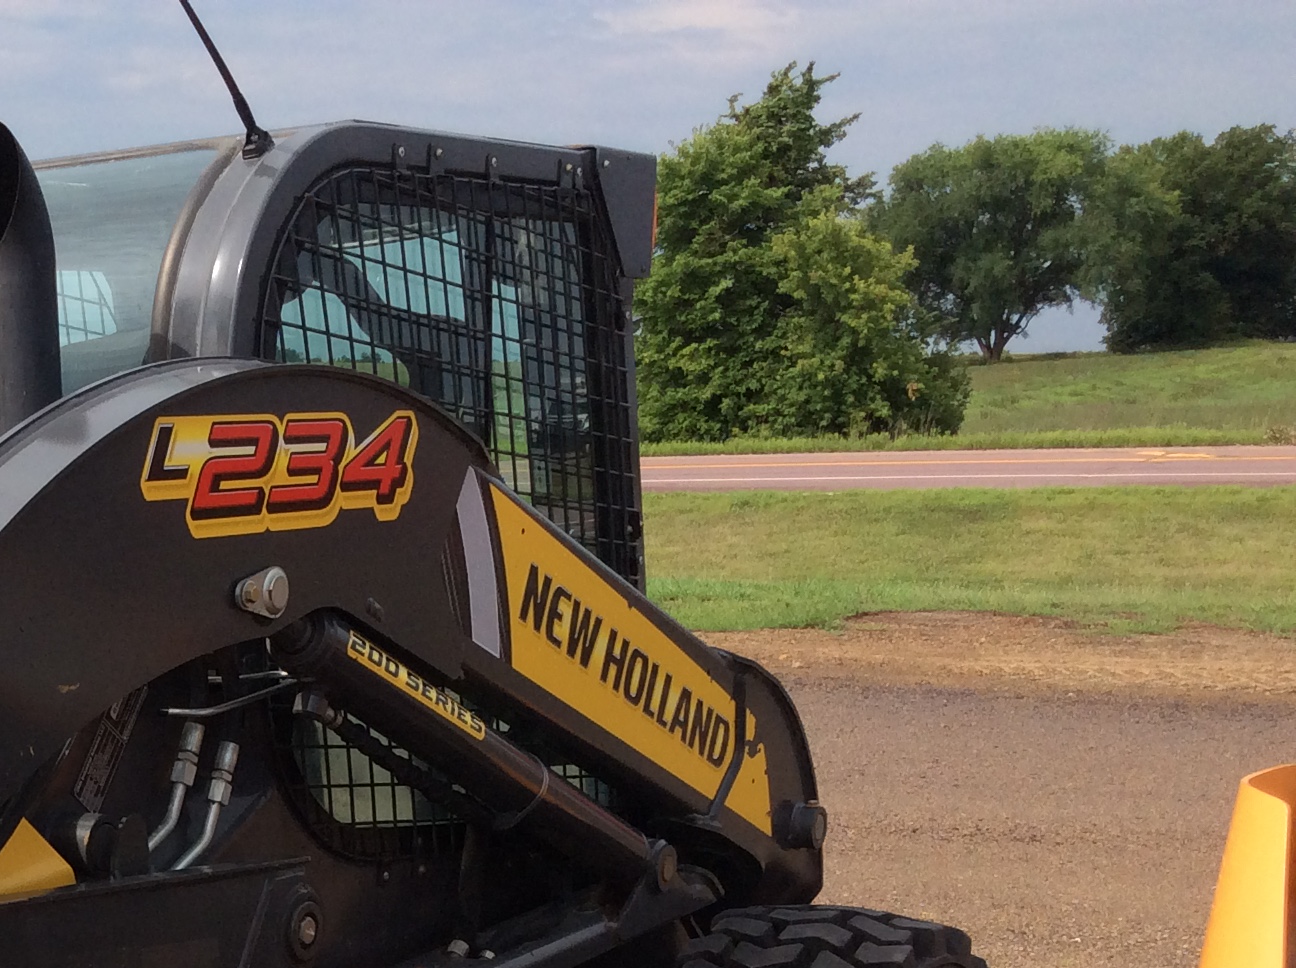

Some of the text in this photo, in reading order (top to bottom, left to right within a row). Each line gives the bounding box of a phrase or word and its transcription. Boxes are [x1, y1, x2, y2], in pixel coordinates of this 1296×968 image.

[143, 414, 414, 523] L234
[350, 634, 484, 734] 200 SERIES
[518, 562, 731, 769] NEW HOLLAND
